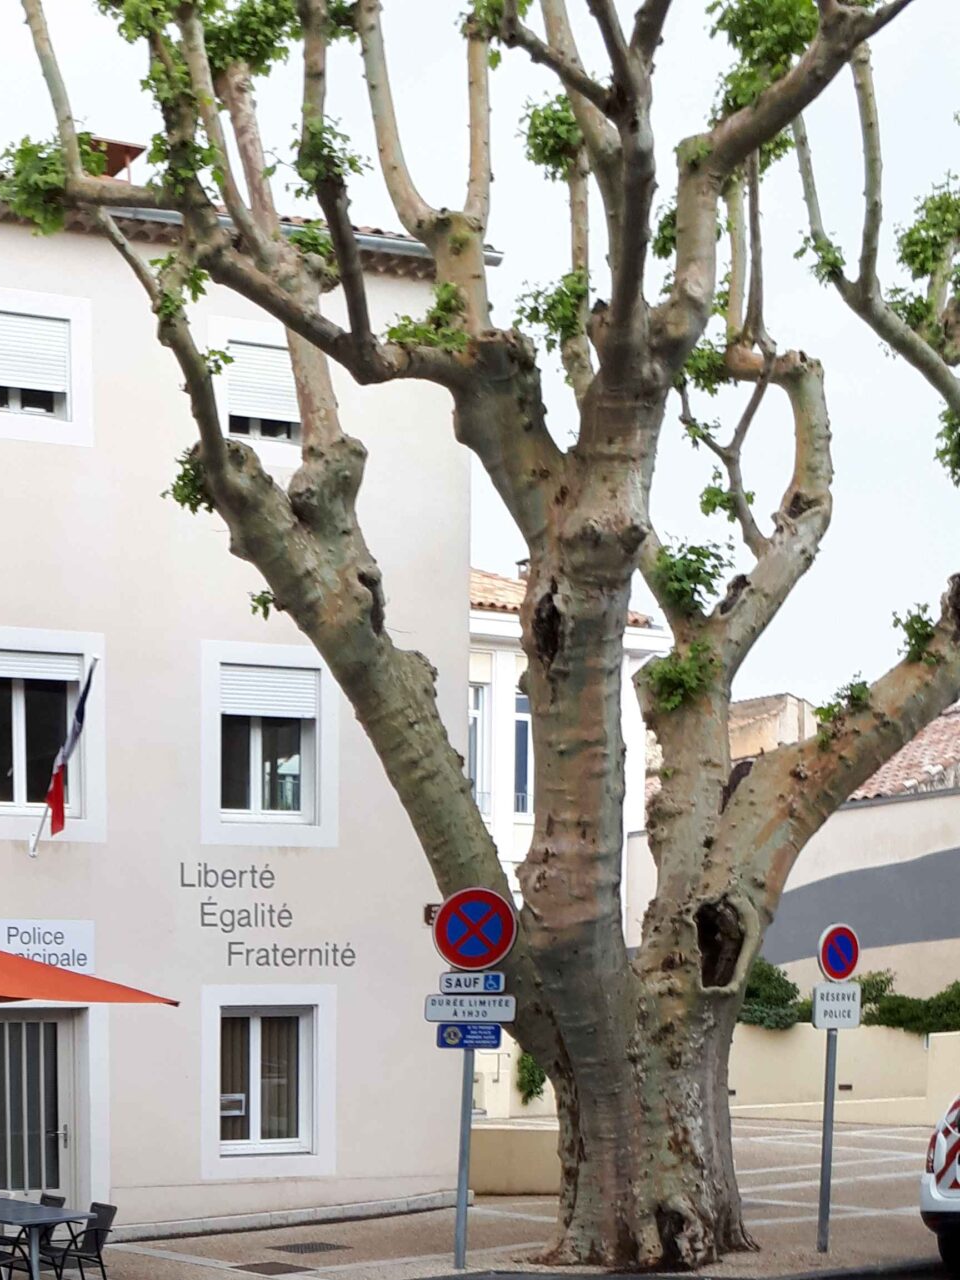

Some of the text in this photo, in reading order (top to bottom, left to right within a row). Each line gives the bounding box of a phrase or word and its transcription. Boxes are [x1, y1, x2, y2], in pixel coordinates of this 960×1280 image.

[180, 862, 275, 889] Liberté
[200, 896, 293, 933] Égalité
[6, 926, 65, 945] Police
[227, 942, 356, 967] Fraternité
[444, 977, 480, 989] SAUF
[431, 998, 510, 1007] DURÉE LIMITÉE
[461, 1010, 488, 1018] 1H30
[823, 1009, 852, 1019] POLICE
